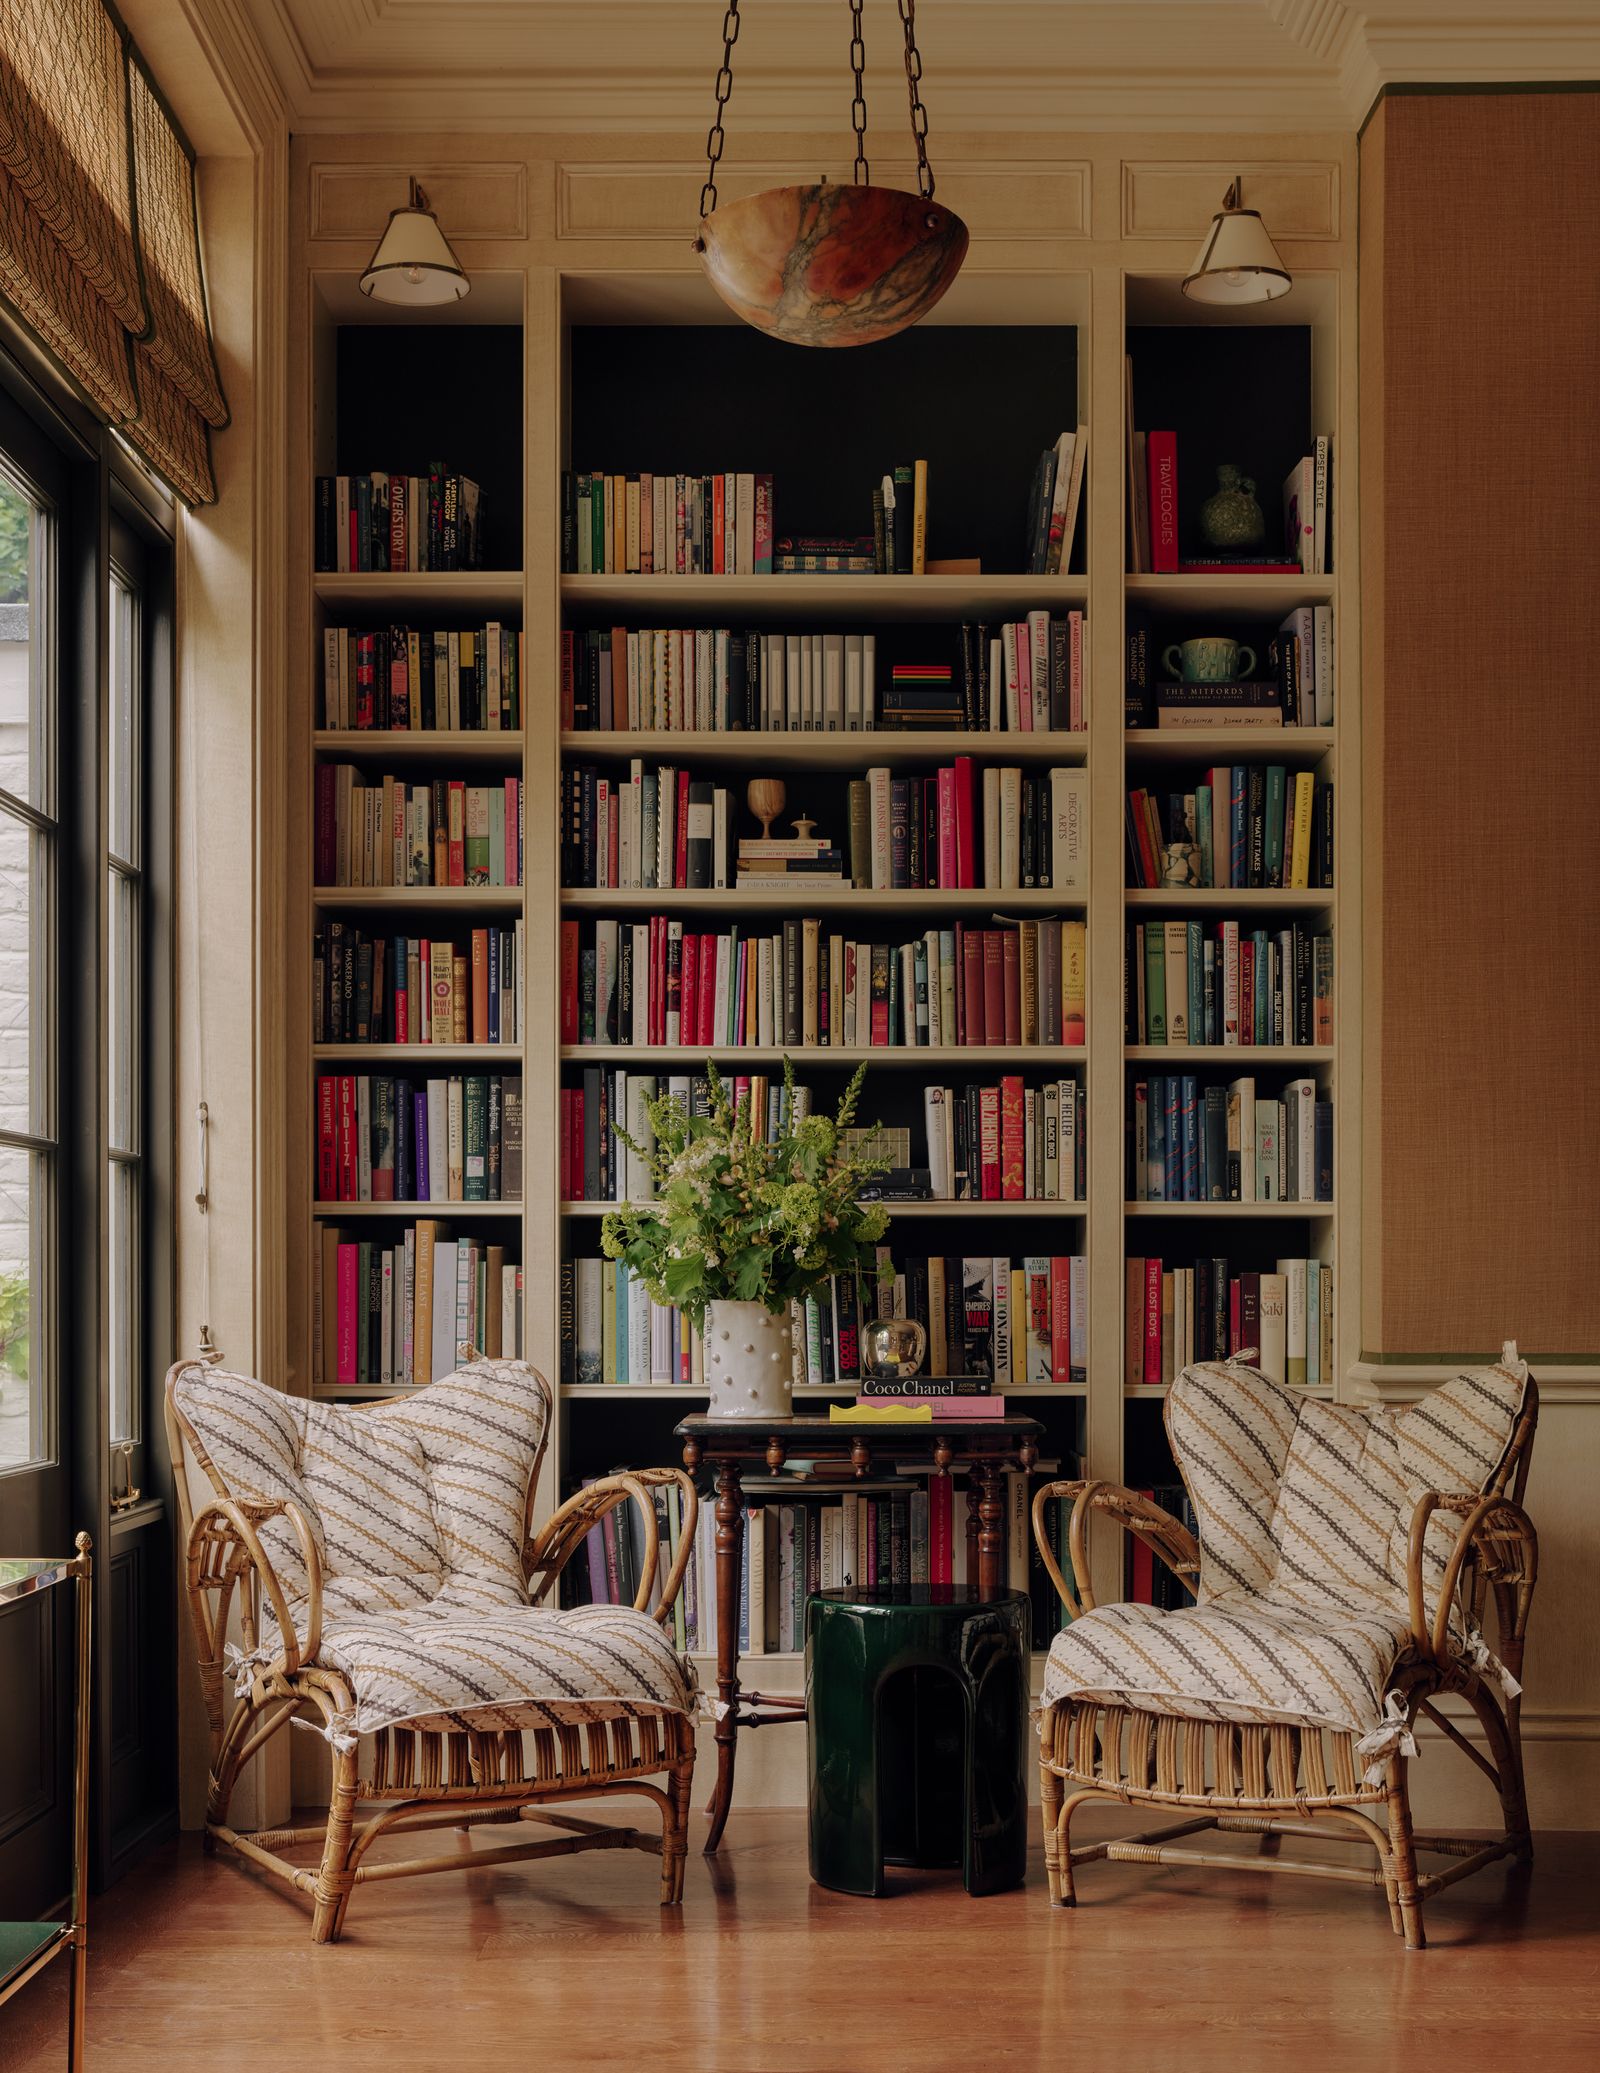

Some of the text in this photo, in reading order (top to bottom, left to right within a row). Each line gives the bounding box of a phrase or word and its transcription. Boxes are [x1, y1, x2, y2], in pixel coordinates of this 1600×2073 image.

[321, 479, 330, 507] MAYHEW
[1315, 440, 1325, 509] GYPSET STYLE
[392, 486, 405, 553] OVERSTORY
[449, 484, 457, 522] GENTLEMAN
[1159, 455, 1173, 545] TRAVELOGUES
[1035, 617, 1046, 648] THE SPY
[1073, 627, 1081, 672] ABSOLUTELY
[1302, 615, 1314, 647] A.A.Gill
[1320, 620, 1328, 652] THE BEST
[1034, 656, 1048, 690] TRAITOR
[1054, 634, 1067, 694] Two Novels
[1129, 636, 1138, 681] CHANNON
[1137, 630, 1147, 689] HENRY 'CHIPS'
[1190, 687, 1244, 696] MITFORDS
[394, 785, 403, 839] PERFECT PITCH
[468, 798, 482, 835] Bryson
[477, 810, 487, 825] Bill
[583, 774, 591, 822] MARK HADDON
[599, 783, 607, 826] TED TALKS
[644, 791, 653, 846] NINE LESSONS
[875, 774, 888, 853] THE HABSBURGS
[1005, 779, 1016, 841] BIG HOUSE
[1300, 781, 1311, 834] BRYAN FERRY
[416, 804, 424, 843] RIVIERA SET
[1057, 812, 1068, 841] ARTS
[1068, 792, 1079, 862] DECORATIVE
[1253, 815, 1263, 839] WHAT
[1253, 848, 1262, 872] TAKES
[344, 948, 354, 999] MASKERADO
[433, 965, 450, 973] Hilary
[1228, 928, 1238, 1013] FIRE AND FURY
[1243, 956, 1251, 993] AMY TAN
[1296, 930, 1305, 979] ANTOINETTE
[599, 941, 608, 1015] AGATHA CHRISTIE
[622, 944, 631, 1012] The Greatest Collector
[930, 969, 939, 1028] THE PURSUIT ART
[1024, 939, 1035, 1028] BARRY HUMPHRIES
[433, 999, 451, 1008] WOLF
[434, 1008, 451, 1016] HALL
[1274, 990, 1282, 1032] PHILIP ROTH
[1300, 985, 1308, 1033] IAN DUNLOP
[322, 1081, 332, 1134] BEN MACINTYRE
[379, 1081, 389, 1129] Princesses
[449, 1099, 457, 1149] DISCLAIMER
[472, 1099, 480, 1154] JOYCE GRENFELL
[637, 1101, 645, 1137] BENNETT
[934, 1105, 942, 1133] THRIVE
[1060, 1082, 1073, 1137] ZOE HELLER
[434, 1087, 443, 1169] THE WHITE ROAD
[981, 1094, 999, 1165] SOLZHENITSYN
[1047, 1117, 1056, 1158] BLACK BOX
[418, 1230, 429, 1308] HOME AT LAST
[1031, 1277, 1047, 1302] Falcon
[1216, 1263, 1224, 1279] Anne
[1298, 1267, 1306, 1315] Howard Jacobson
[441, 1290, 450, 1316] ROBERT
[560, 1263, 573, 1340] LOST GIRLS
[965, 1301, 991, 1312] EMPIRES
[966, 1311, 991, 1327] WAR
[996, 1261, 1008, 1370] ME ELTON JOHN
[1060, 1279, 1068, 1341] LISA JARDINE
[1148, 1265, 1158, 1337] THE LOST BOYS
[1260, 1302, 1284, 1318] Saki
[1324, 1287, 1332, 1317] SHARPE
[641, 1309, 649, 1369] BUNNY MELLON
[808, 1340, 820, 1368] DUKE
[838, 1330, 850, 1369] BLOOD
[848, 1324, 857, 1368] TROUBLED
[1131, 1308, 1142, 1362] Nancy Cunard
[863, 1380, 955, 1396] Coco Chanel
[1015, 1482, 1024, 1520] CHANEL
[823, 1535, 831, 1588] LOOK BOOK
[849, 1528, 857, 1551] HICKS
[881, 1544, 890, 1566] ROPER
[752, 1540, 763, 1609] SNOWDON
[795, 1524, 803, 1622] LONDON PERCEIVED
[740, 1594, 748, 1628] MELLON
